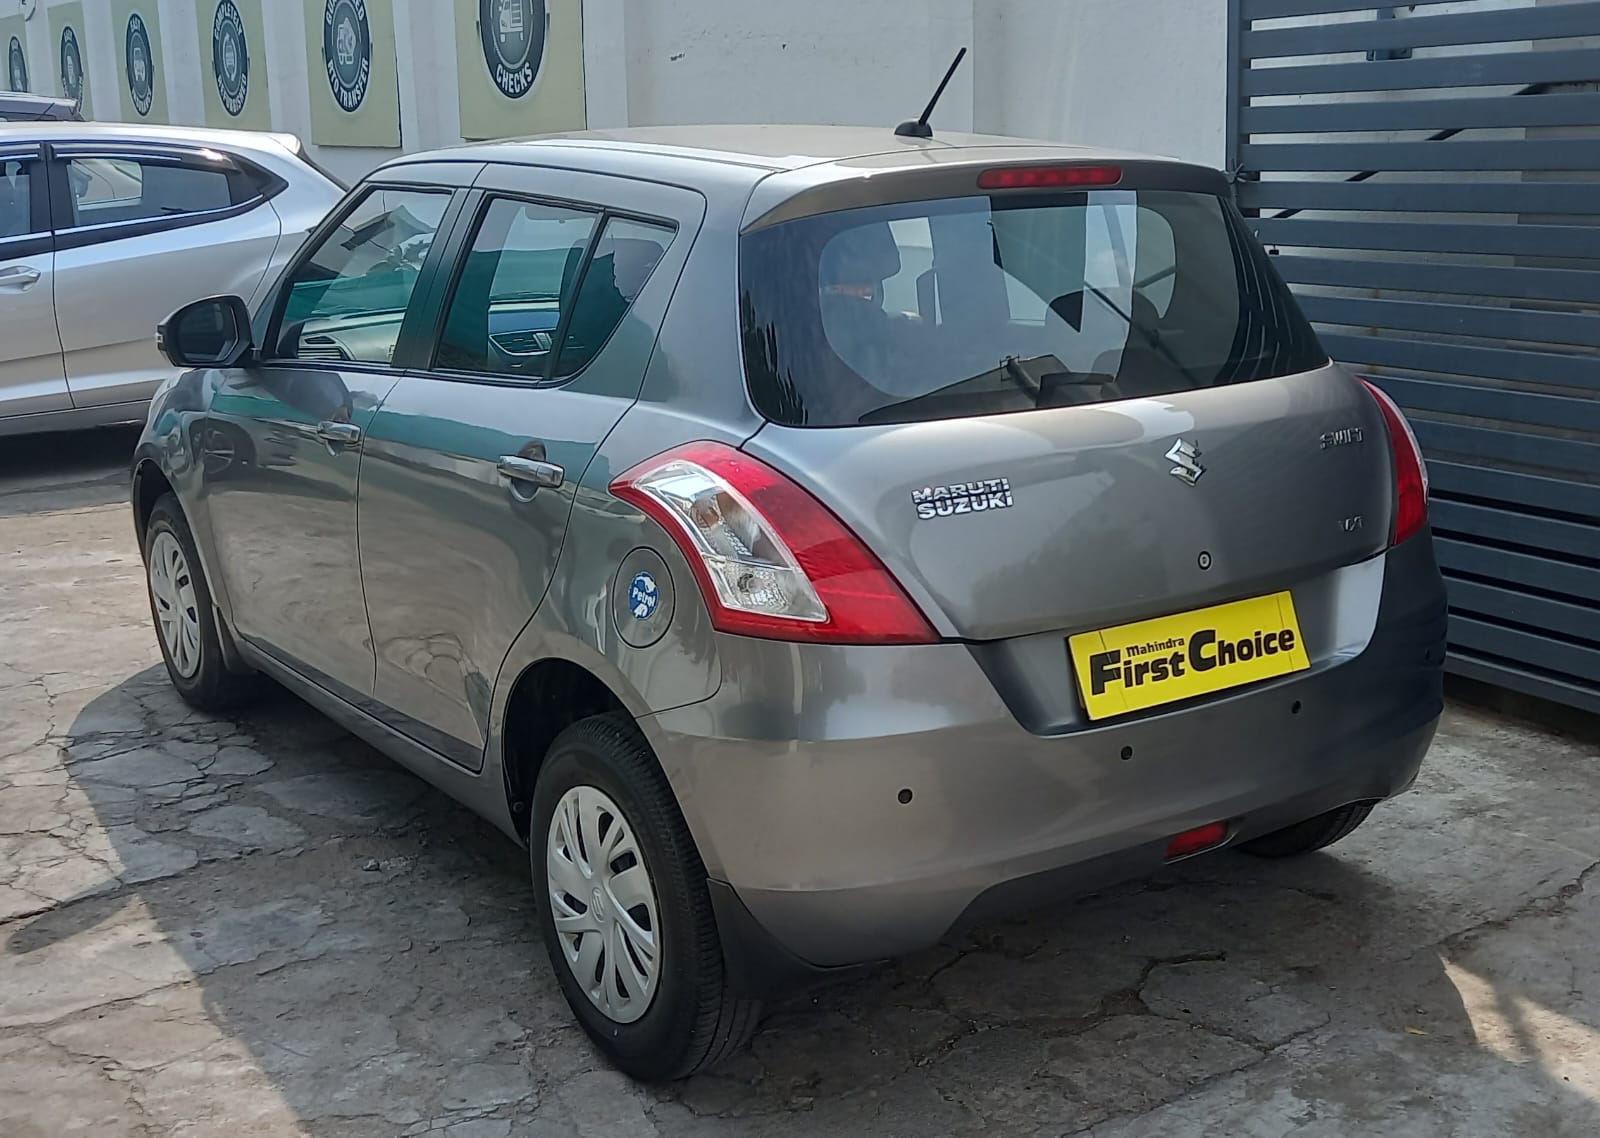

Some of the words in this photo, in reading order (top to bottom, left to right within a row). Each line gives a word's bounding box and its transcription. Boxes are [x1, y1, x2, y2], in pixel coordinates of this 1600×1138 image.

[328, 58, 340, 94] RTO
[339, 57, 369, 108] TRANSFER
[496, 61, 533, 94] CHECKS
[911, 477, 1010, 503] MARUTI
[917, 490, 1014, 520] SUZUKI
[631, 586, 656, 607] Petrol
[1126, 636, 1185, 657] Mahindra
[1089, 649, 1185, 696] First
[1188, 629, 1295, 672] Choice
